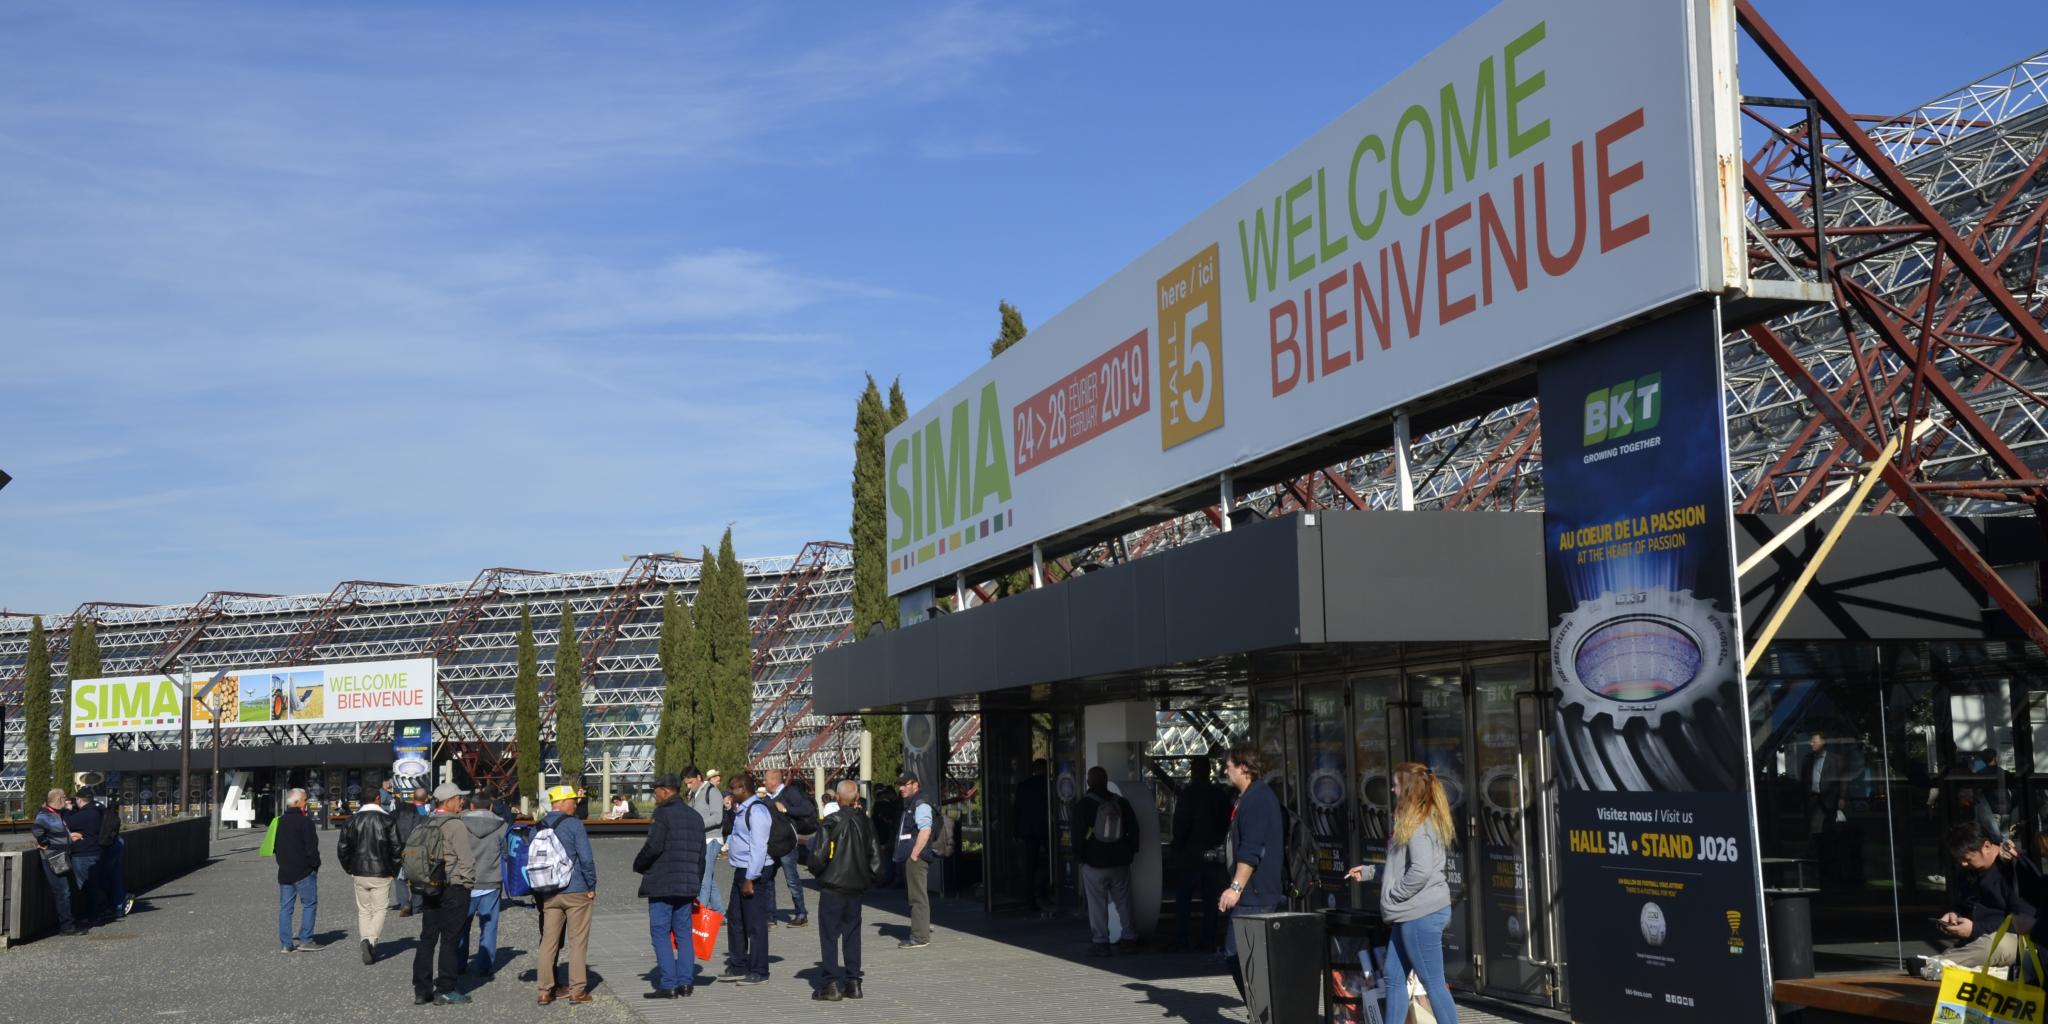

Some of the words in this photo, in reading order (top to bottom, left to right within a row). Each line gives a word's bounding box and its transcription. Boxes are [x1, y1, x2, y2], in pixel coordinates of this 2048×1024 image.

[1238, 20, 1551, 303] WELCOME
[1269, 106, 1650, 399] BIENVENUE
[1162, 281, 1187, 311] here
[1198, 256, 1214, 289] ici
[1101, 344, 1143, 423] 2019
[1168, 320, 1178, 425] HALL
[1183, 302, 1213, 423] 5
[1069, 403, 1098, 438] FEBRUARY
[1585, 382, 1660, 436] BKT
[888, 380, 1013, 552] SIMA
[1583, 447, 1618, 465] GROWING
[1619, 436, 1661, 456] TOGETHER
[1560, 531, 1575, 551] AU
[1615, 520, 1630, 540] DE
[1633, 515, 1649, 537] LA
[1650, 504, 1706, 533] PASSION
[1577, 549, 1588, 565] AT
[1588, 545, 1604, 562] THE
[1606, 541, 1633, 560] HEART
[1635, 538, 1646, 555] OF
[1648, 532, 1686, 552] PASSION
[75, 680, 181, 721] SIMA
[329, 672, 408, 693] WELCOME
[337, 690, 423, 709] BIENVENUE
[221, 771, 256, 829] 4
[1596, 807, 1628, 820] Visitez
[1629, 811, 1653, 822] nous
[1660, 809, 1680, 823] Visit
[1682, 812, 1693, 824] us
[1570, 830, 1606, 854] HALL
[1608, 831, 1629, 855] 5A
[1641, 833, 1694, 860] STAND
[1697, 835, 1739, 862] J026
